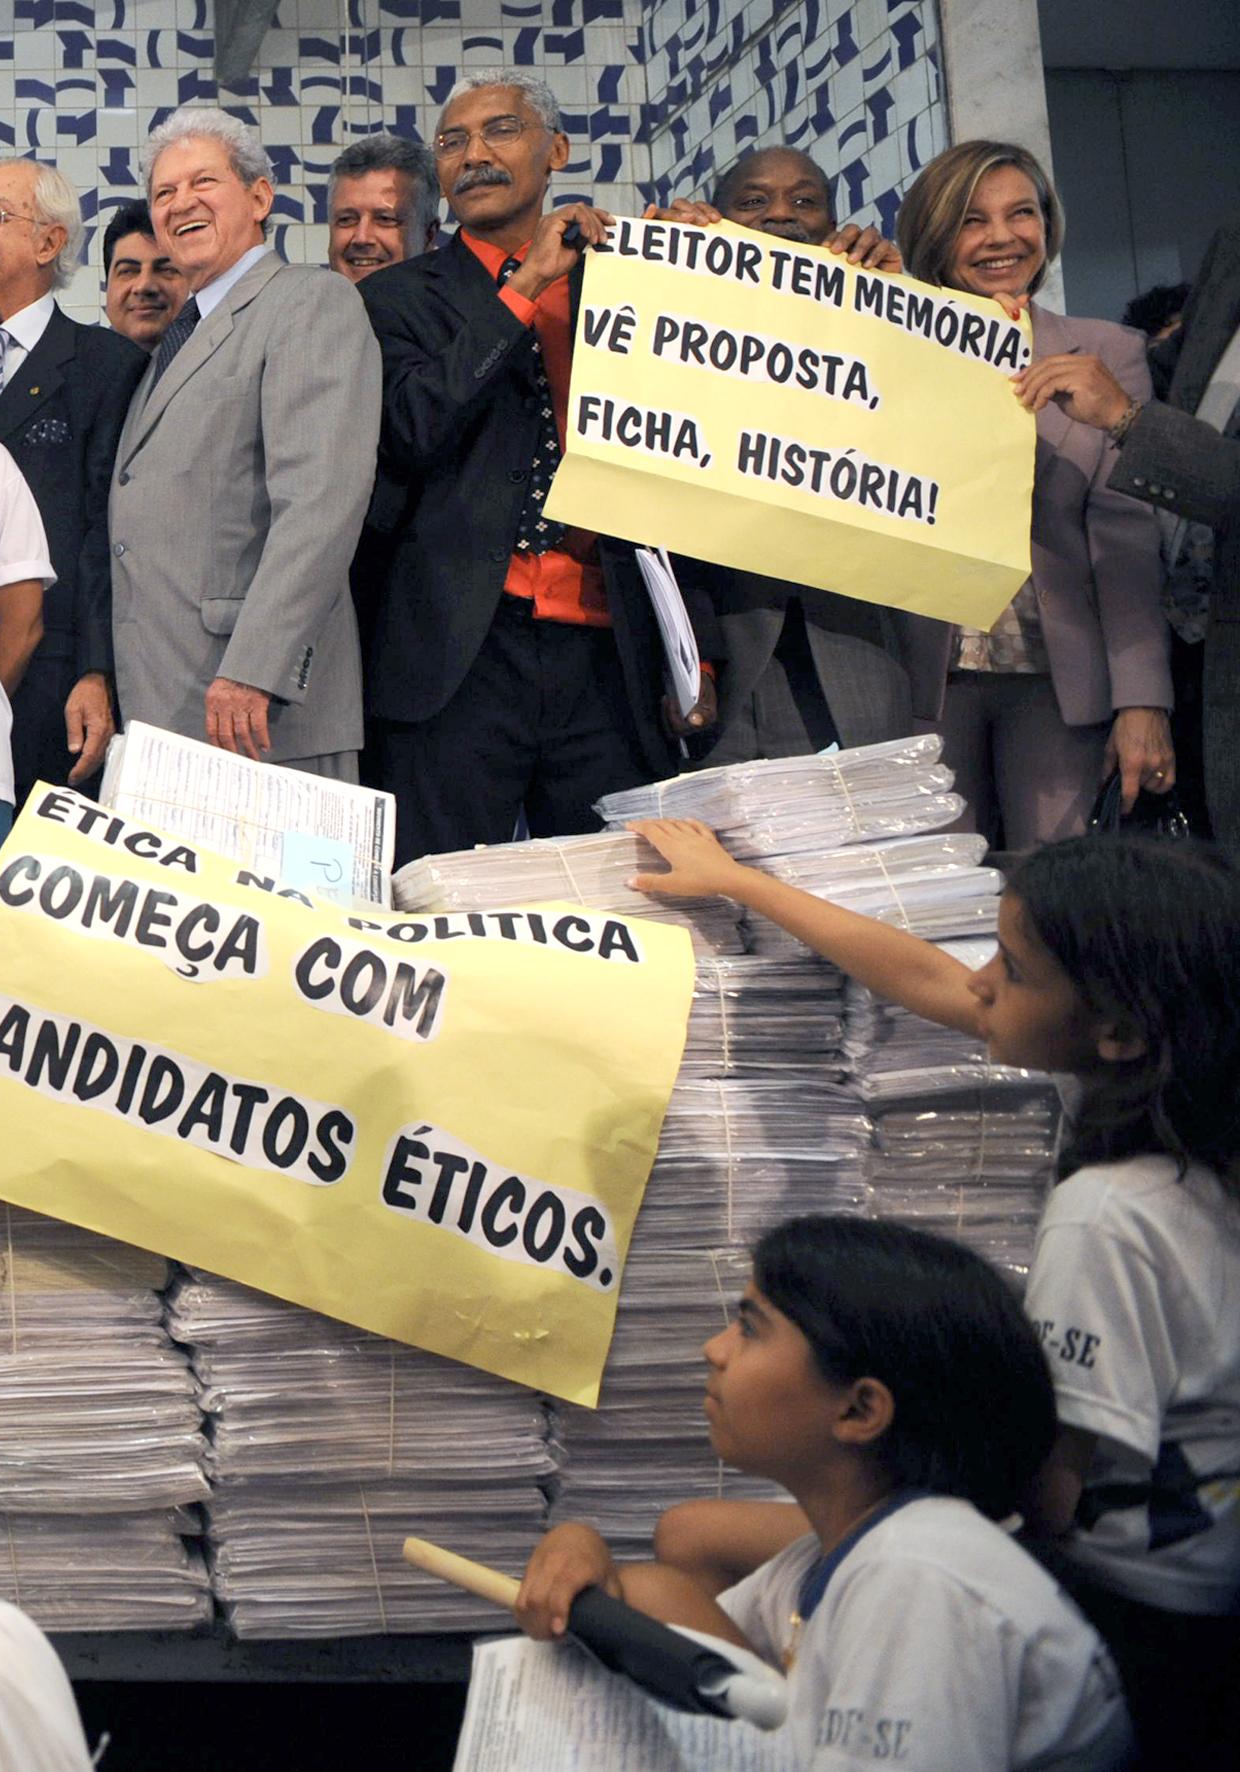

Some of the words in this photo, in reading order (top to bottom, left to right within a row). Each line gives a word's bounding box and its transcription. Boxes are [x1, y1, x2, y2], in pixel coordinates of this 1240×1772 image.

[584, 305, 636, 354] VÊ
[653, 316, 879, 410] PROPOSTA,
[769, 250, 845, 308] TEM
[854, 275, 1031, 372] MEMÓRIA:
[577, 396, 711, 468] FICHA,
[738, 432, 939, 525] HISTÓRIA!
[37, 791, 197, 874] ÉTICA
[236, 870, 314, 908] NA
[295, 936, 447, 1040] COM
[382, 1125, 613, 1287] ÉTICOS.
